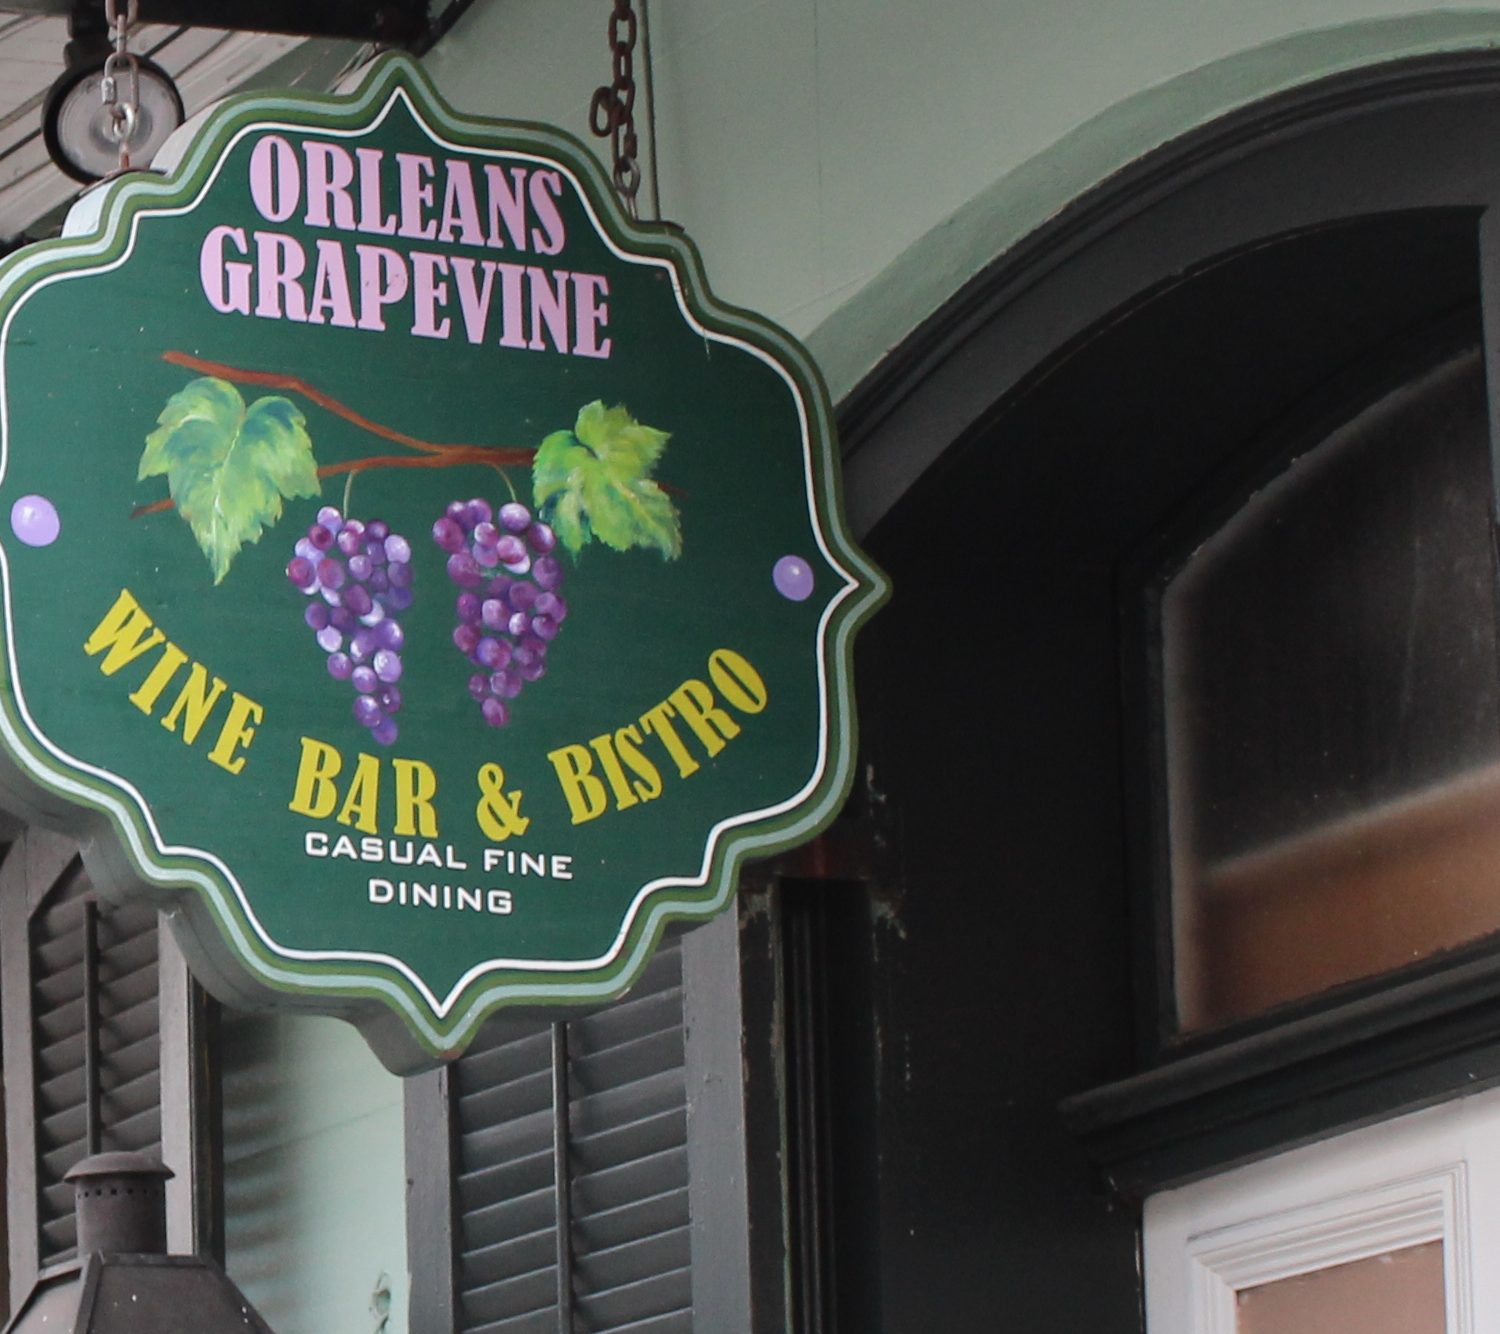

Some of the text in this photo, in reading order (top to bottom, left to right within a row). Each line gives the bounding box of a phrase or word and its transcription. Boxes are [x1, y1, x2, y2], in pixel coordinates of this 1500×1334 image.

[250, 134, 566, 254] ORLEANS
[201, 225, 612, 358] GRAPEVINE
[84, 590, 768, 842] WINE BAR & BISTRO
[304, 831, 574, 880] CASUAL FINE
[368, 878, 513, 914] DINING
